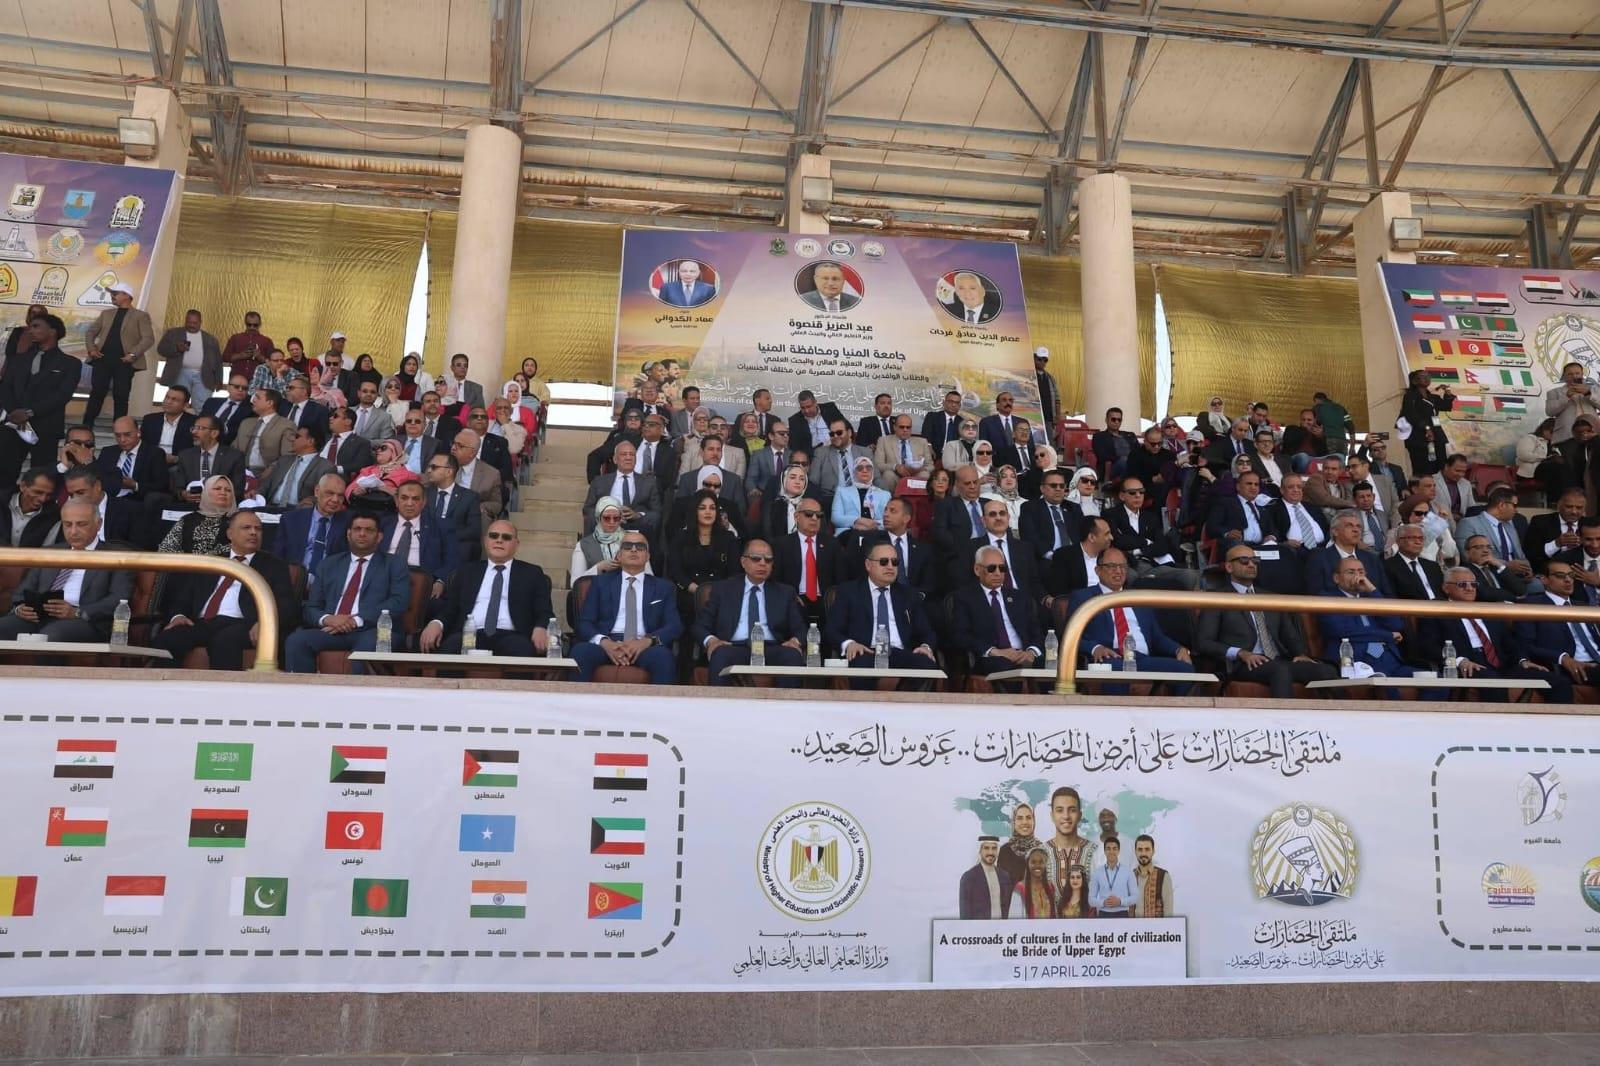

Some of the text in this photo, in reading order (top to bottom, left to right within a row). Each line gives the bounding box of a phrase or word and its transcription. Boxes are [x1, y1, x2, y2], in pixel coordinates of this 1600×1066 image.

[655, 315, 692, 323] الكدواني
[789, 318, 822, 328] قنصوة
[825, 322, 852, 332] العزيز
[930, 328, 953, 337] فرحات
[956, 330, 976, 338] صادق
[979, 332, 998, 340] الدين
[758, 342, 906, 363] جامعة المنيا ومحافظة المنيا
[737, 362, 768, 371] الجنسيات
[838, 370, 869, 378] بالجامعات
[69, 783, 94, 792] العراق
[203, 785, 240, 794] السعودية
[341, 788, 372, 797] السودان
[474, 791, 505, 800] فلسطين
[612, 795, 627, 804] مصر
[207, 854, 224, 864] ليبيا
[341, 857, 363, 866] تونس
[471, 859, 501, 868] الصومال
[604, 861, 630, 870] الكويت
[762, 846, 772, 875] Ministry
[768, 883, 786, 904] Higher
[785, 899, 819, 914] Education
[821, 903, 834, 914] and
[834, 881, 859, 908] Scientific
[855, 848, 864, 881] Research
[240, 926, 270, 934] باكستان
[360, 927, 394, 936] بنجلاديش
[759, 930, 799, 938] العربية
[828, 930, 867, 938] جمهورية
[1492, 925, 1512, 934] مطروح
[940, 931, 1181, 945] A crossroads of cultures in the land of civilization
[1002, 945, 1125, 958] the Bride of Upper Egypt
[1013, 967, 1021, 978] 5
[1031, 966, 1038, 977] 7
[1041, 966, 1078, 978] APRIL
[1081, 965, 1111, 977] 2026
